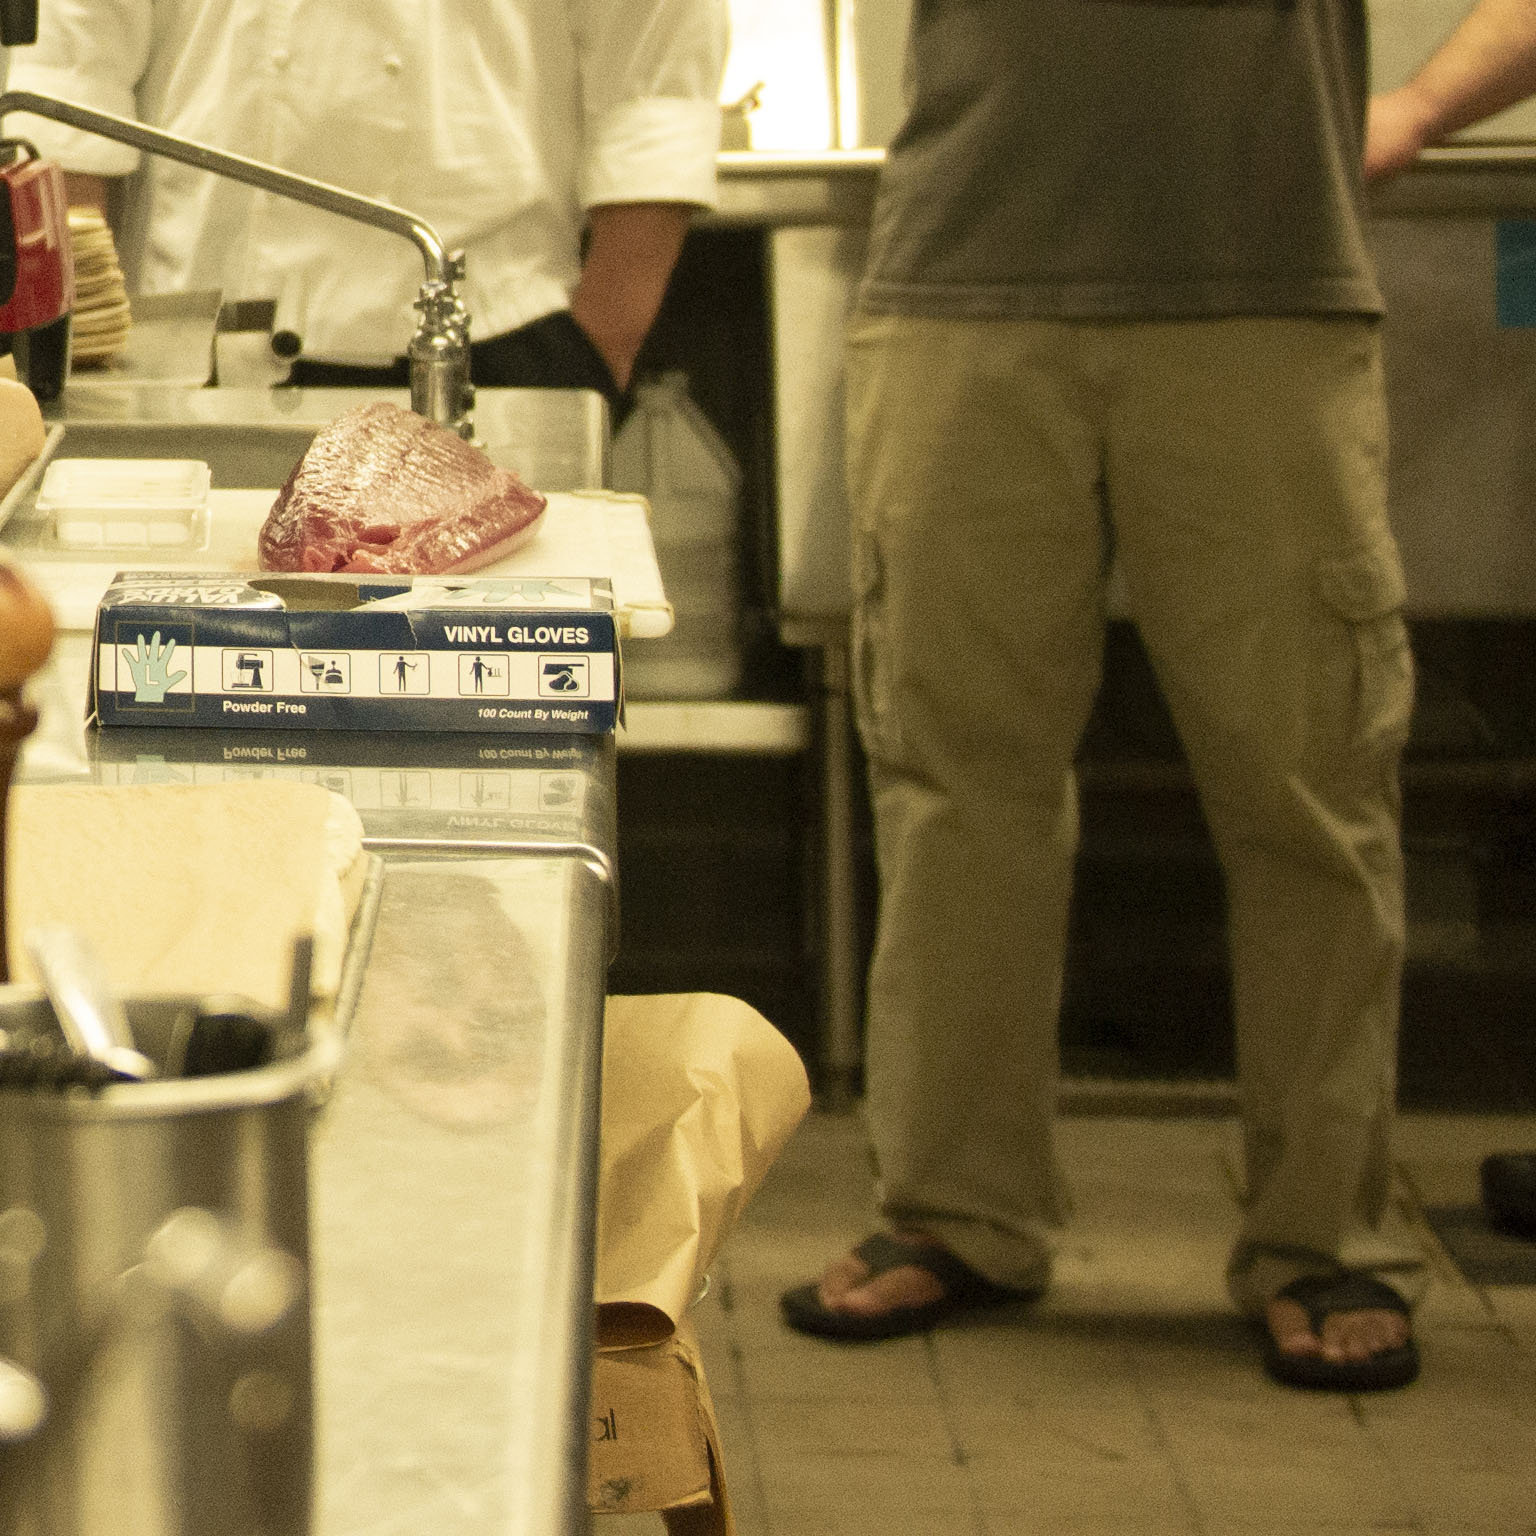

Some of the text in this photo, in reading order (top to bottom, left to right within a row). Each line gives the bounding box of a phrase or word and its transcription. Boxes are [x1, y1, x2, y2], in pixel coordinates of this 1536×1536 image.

[444, 625, 589, 644] VINYL GLOVES
[145, 663, 159, 685] L
[223, 700, 306, 714] Powder Free
[478, 708, 589, 721] 100 Count By Weight
